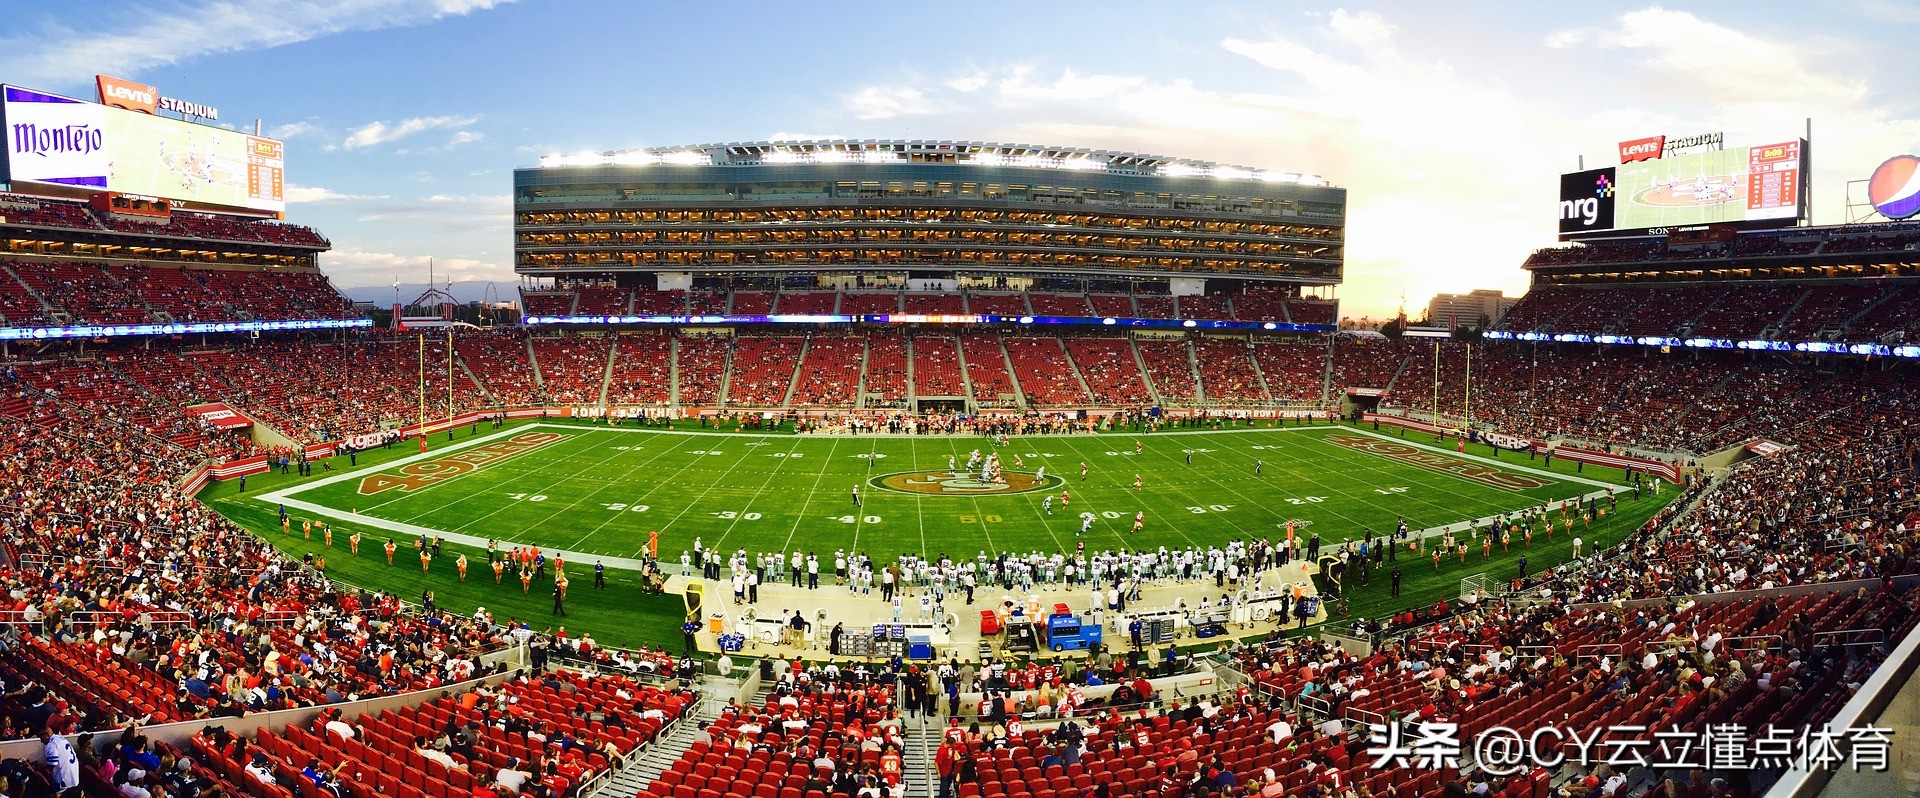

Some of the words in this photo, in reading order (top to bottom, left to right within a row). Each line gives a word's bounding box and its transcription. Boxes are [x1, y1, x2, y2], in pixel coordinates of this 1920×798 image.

[160, 97, 217, 120] STADIUM
[13, 123, 102, 157] Montejo
[1663, 132, 1723, 150] STADIUM
[1560, 197, 1598, 226] nrg
[606, 503, 650, 512] 20
[1186, 504, 1229, 514] 30
[717, 511, 762, 520] 30
[838, 515, 882, 524] 40
[959, 514, 1003, 524] 50
[680, 660, 690, 669] 54
[1009, 724, 1022, 737] 94
[884, 760, 897, 771] 49
[1332, 773, 1340, 788] 7
